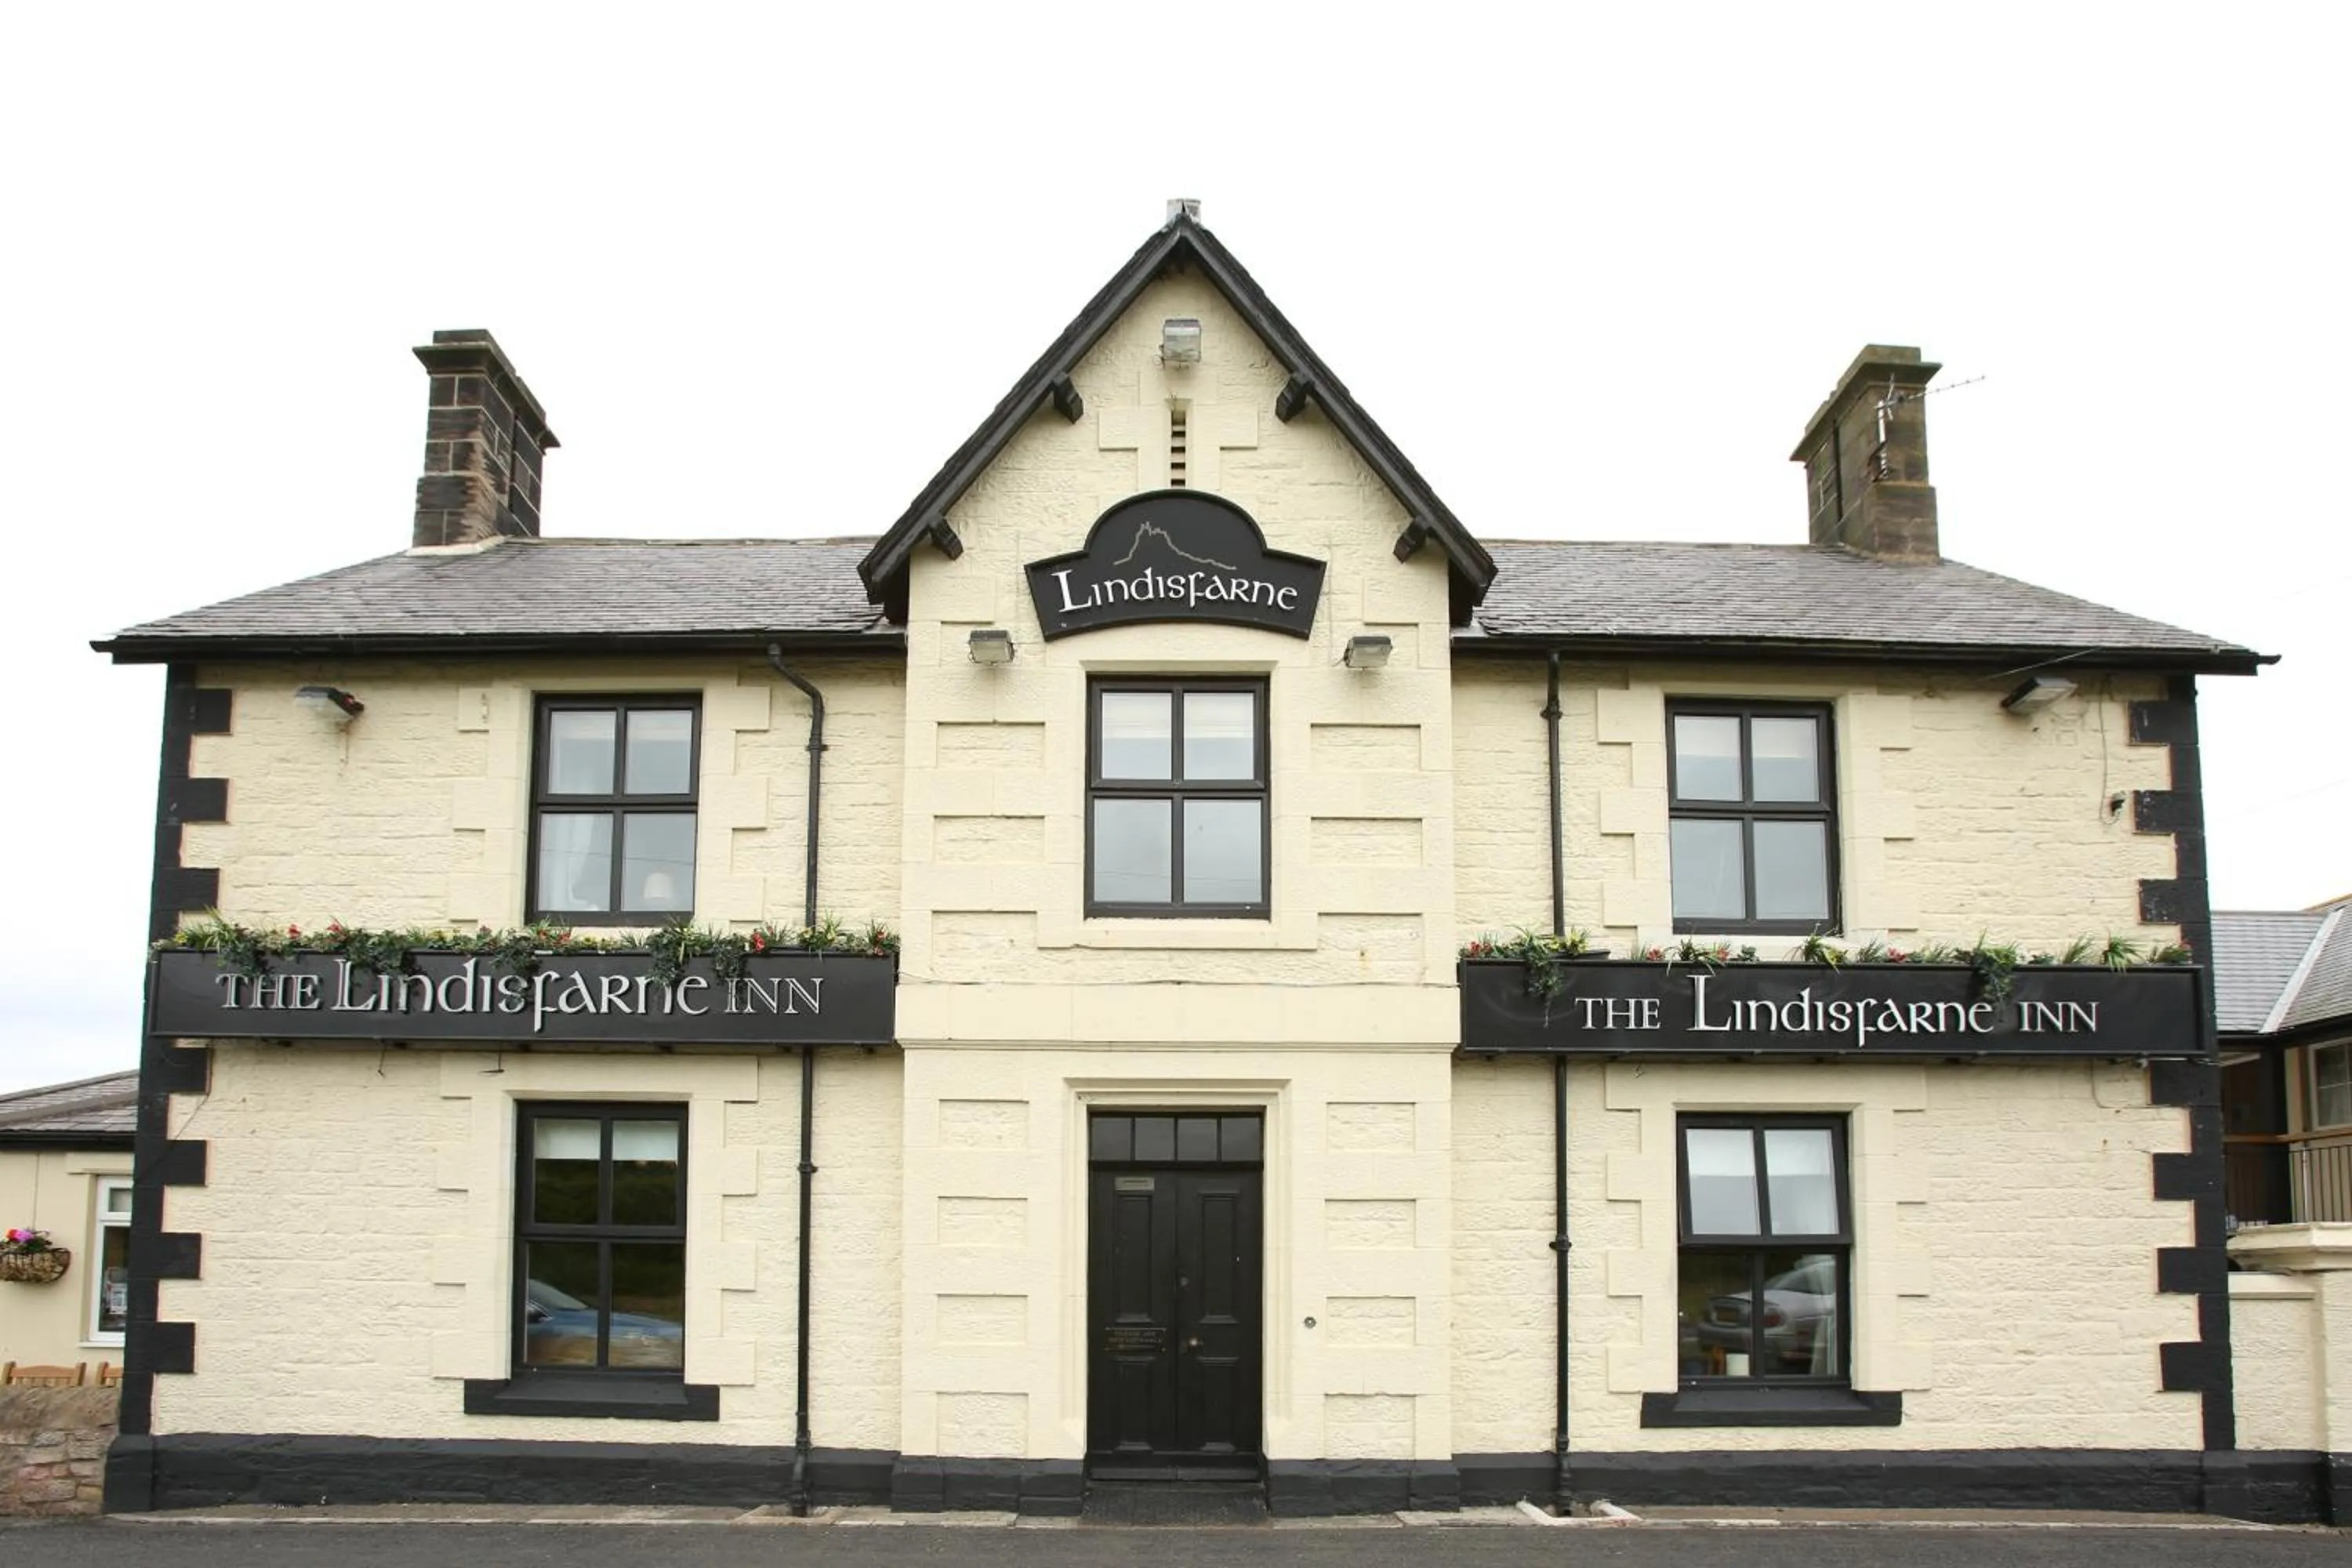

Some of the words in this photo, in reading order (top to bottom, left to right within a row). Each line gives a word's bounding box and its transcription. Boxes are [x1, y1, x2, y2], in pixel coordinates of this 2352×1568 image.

[1051, 566, 1298, 612] Lindisfarne
[216, 973, 321, 1009] THE
[724, 977, 824, 1014] INN
[1574, 997, 1662, 1030] THE
[1686, 974, 1995, 1048] Lindisfarne
[2018, 1000, 2100, 1033] INN
